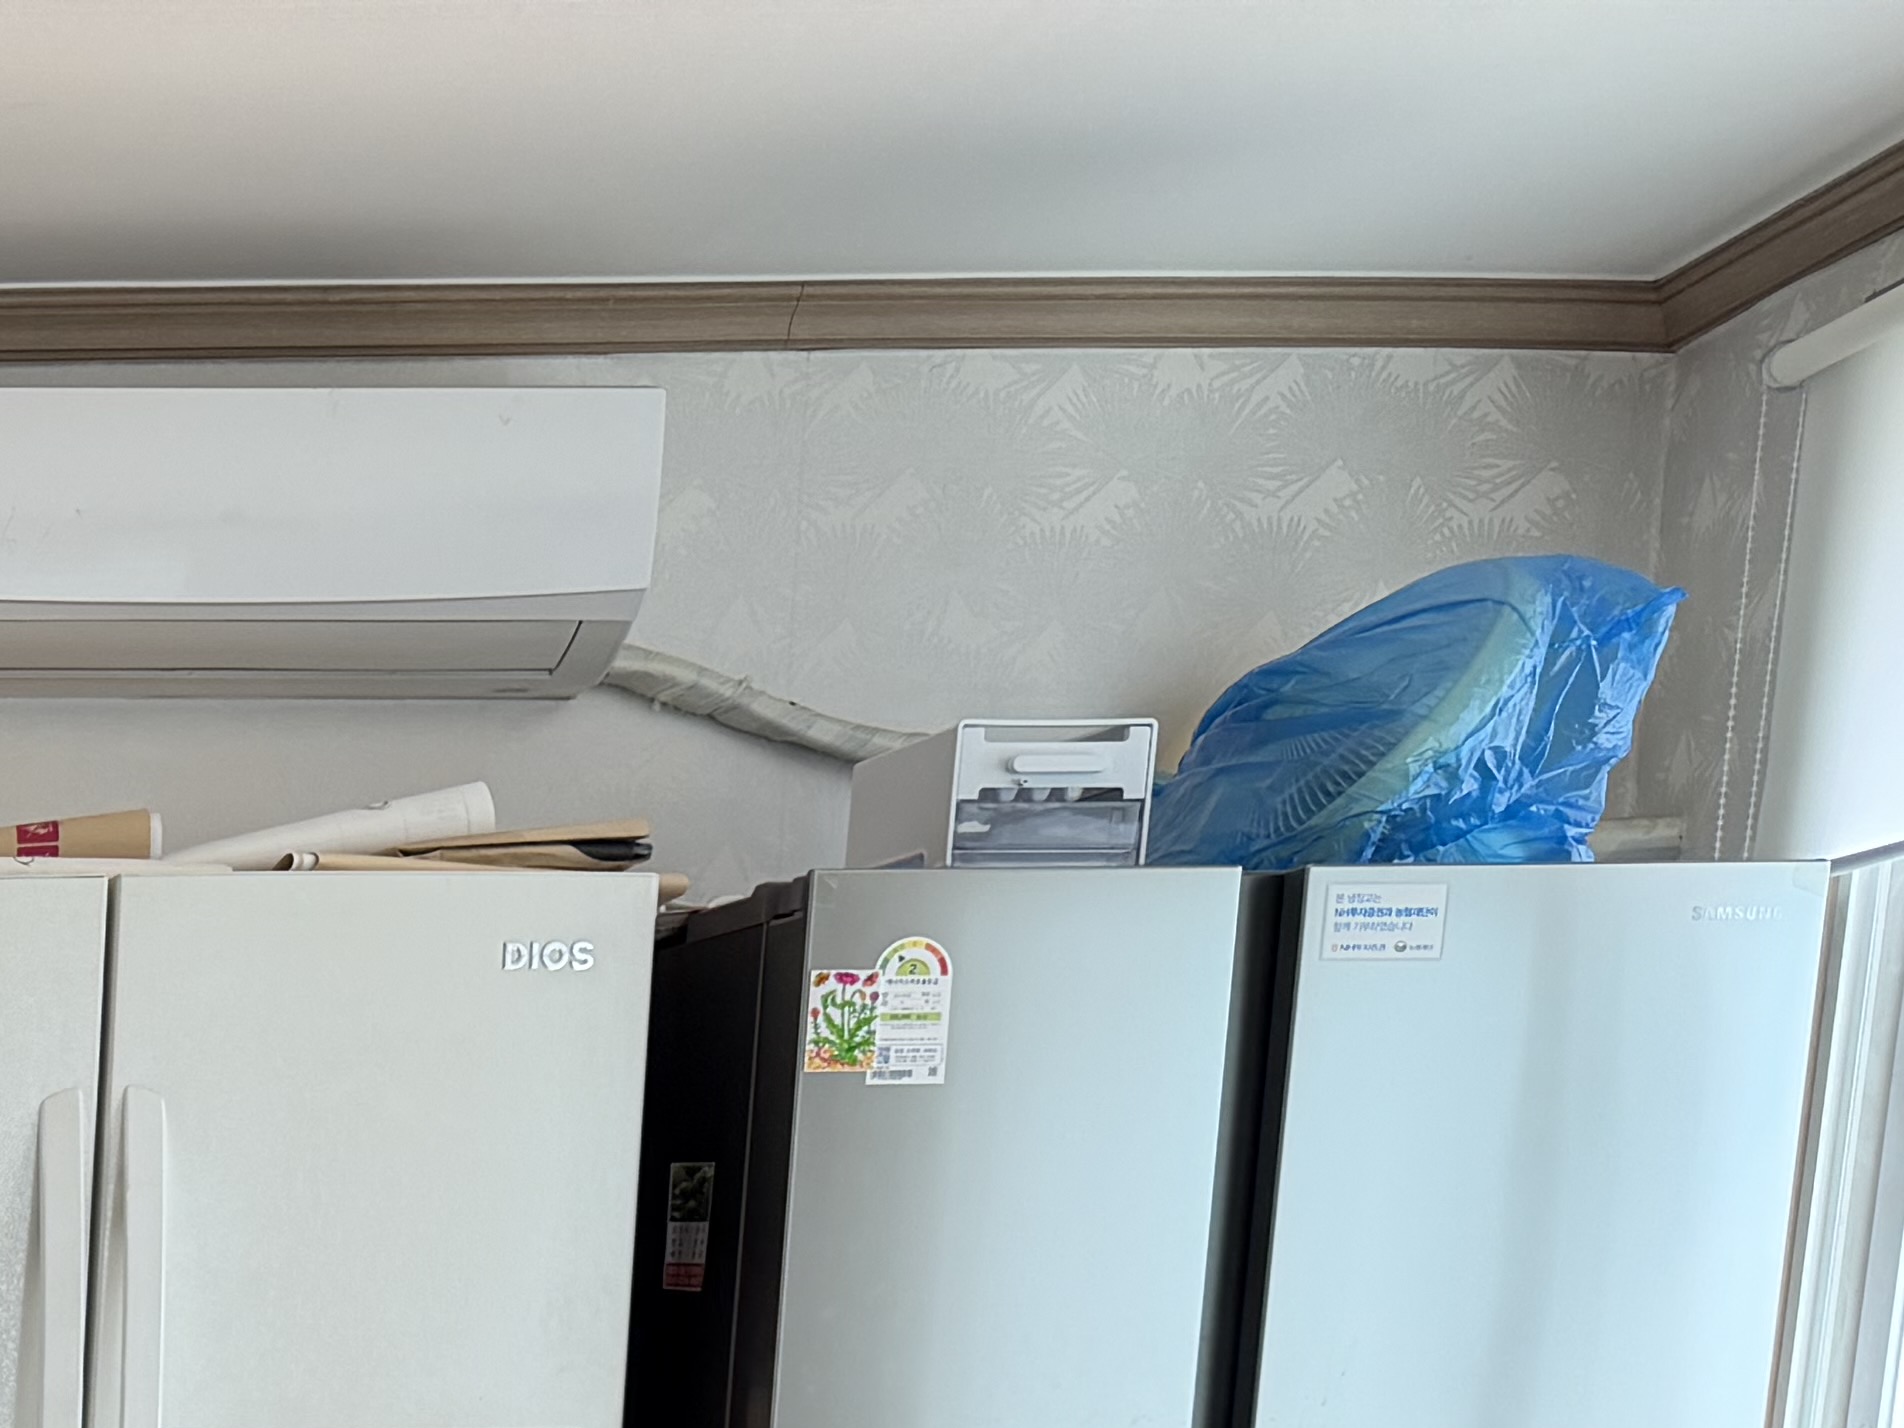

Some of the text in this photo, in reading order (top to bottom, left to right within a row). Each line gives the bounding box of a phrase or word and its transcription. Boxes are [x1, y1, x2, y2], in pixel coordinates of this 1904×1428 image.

[1692, 906, 1782, 920] SAMSUNG
[502, 940, 596, 972] DIOS
[909, 964, 917, 975] 2
